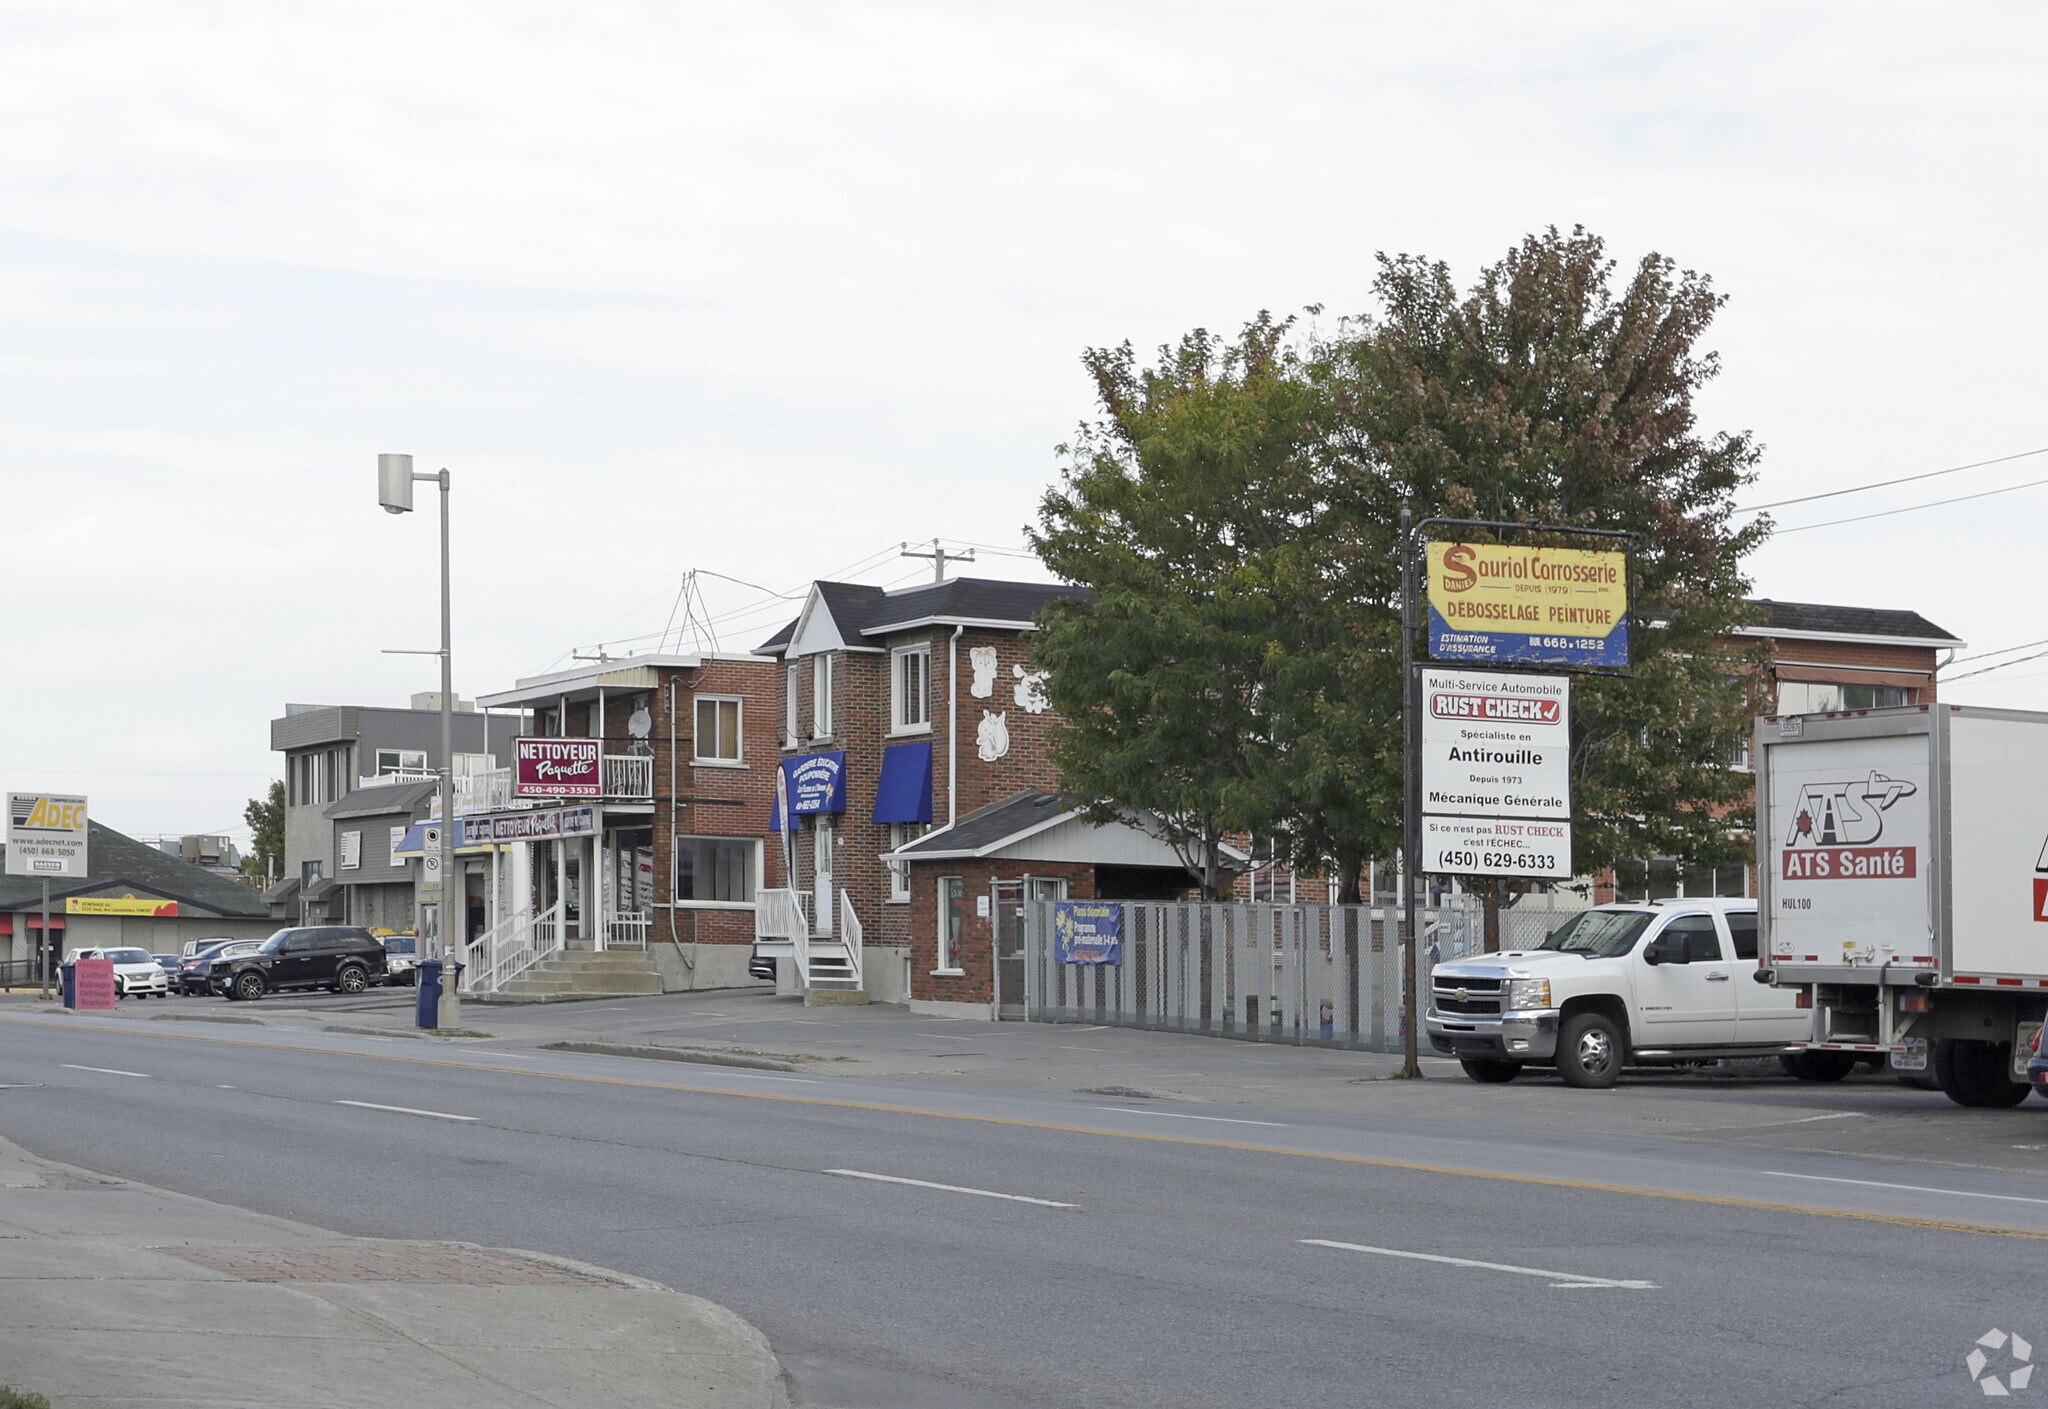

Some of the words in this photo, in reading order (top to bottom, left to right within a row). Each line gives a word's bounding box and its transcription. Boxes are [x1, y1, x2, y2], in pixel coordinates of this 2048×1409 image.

[1443, 545, 1527, 592] Sauriol
[1531, 556, 1617, 584] Carrosserie
[1445, 577, 1474, 591] DANIEL
[1515, 584, 1542, 593] DEPUIS
[1545, 585, 1572, 596] (1979)
[1549, 604, 1612, 625] PEINTURE
[1440, 633, 1489, 644] ESTIMATION
[1439, 643, 1497, 654] D'ASSURANCE
[1429, 678, 1498, 692] Multi-Service
[1500, 682, 1562, 695] Automobile
[1436, 695, 1482, 717] RUST
[1485, 698, 1543, 720] CHECK
[1461, 729, 1516, 741] Spécialiste
[520, 743, 597, 760] NETTOYEUR
[1448, 746, 1543, 765] Antirouille
[535, 760, 594, 781] Paquette
[1469, 774, 1499, 784] Depuis
[1502, 776, 1523, 784] 1973
[522, 786, 597, 795] 450-490-3530
[1429, 791, 1500, 807] Mécanique
[1504, 794, 1563, 808] Générale
[26, 796, 86, 830] ADEC
[1786, 771, 1902, 847] ATS
[495, 816, 530, 838] NETTOYEUR
[1429, 823, 1438, 832] Si
[1453, 824, 1474, 834] n'est
[1476, 828, 1492, 838] pas
[1494, 824, 1524, 836] RUST
[1527, 826, 1564, 837] CHECK
[12, 838, 83, 847] www.adecnet.com
[1463, 838, 1484, 847] c'est
[19, 846, 39, 855] (450)
[41, 847, 76, 857] 668-5050
[1438, 850, 1478, 870] (450)
[1483, 852, 1555, 870] 629-6333
[1786, 851, 1831, 877] ATS
[1839, 849, 1905, 877] Santé
[1782, 898, 1812, 910] HUL100
